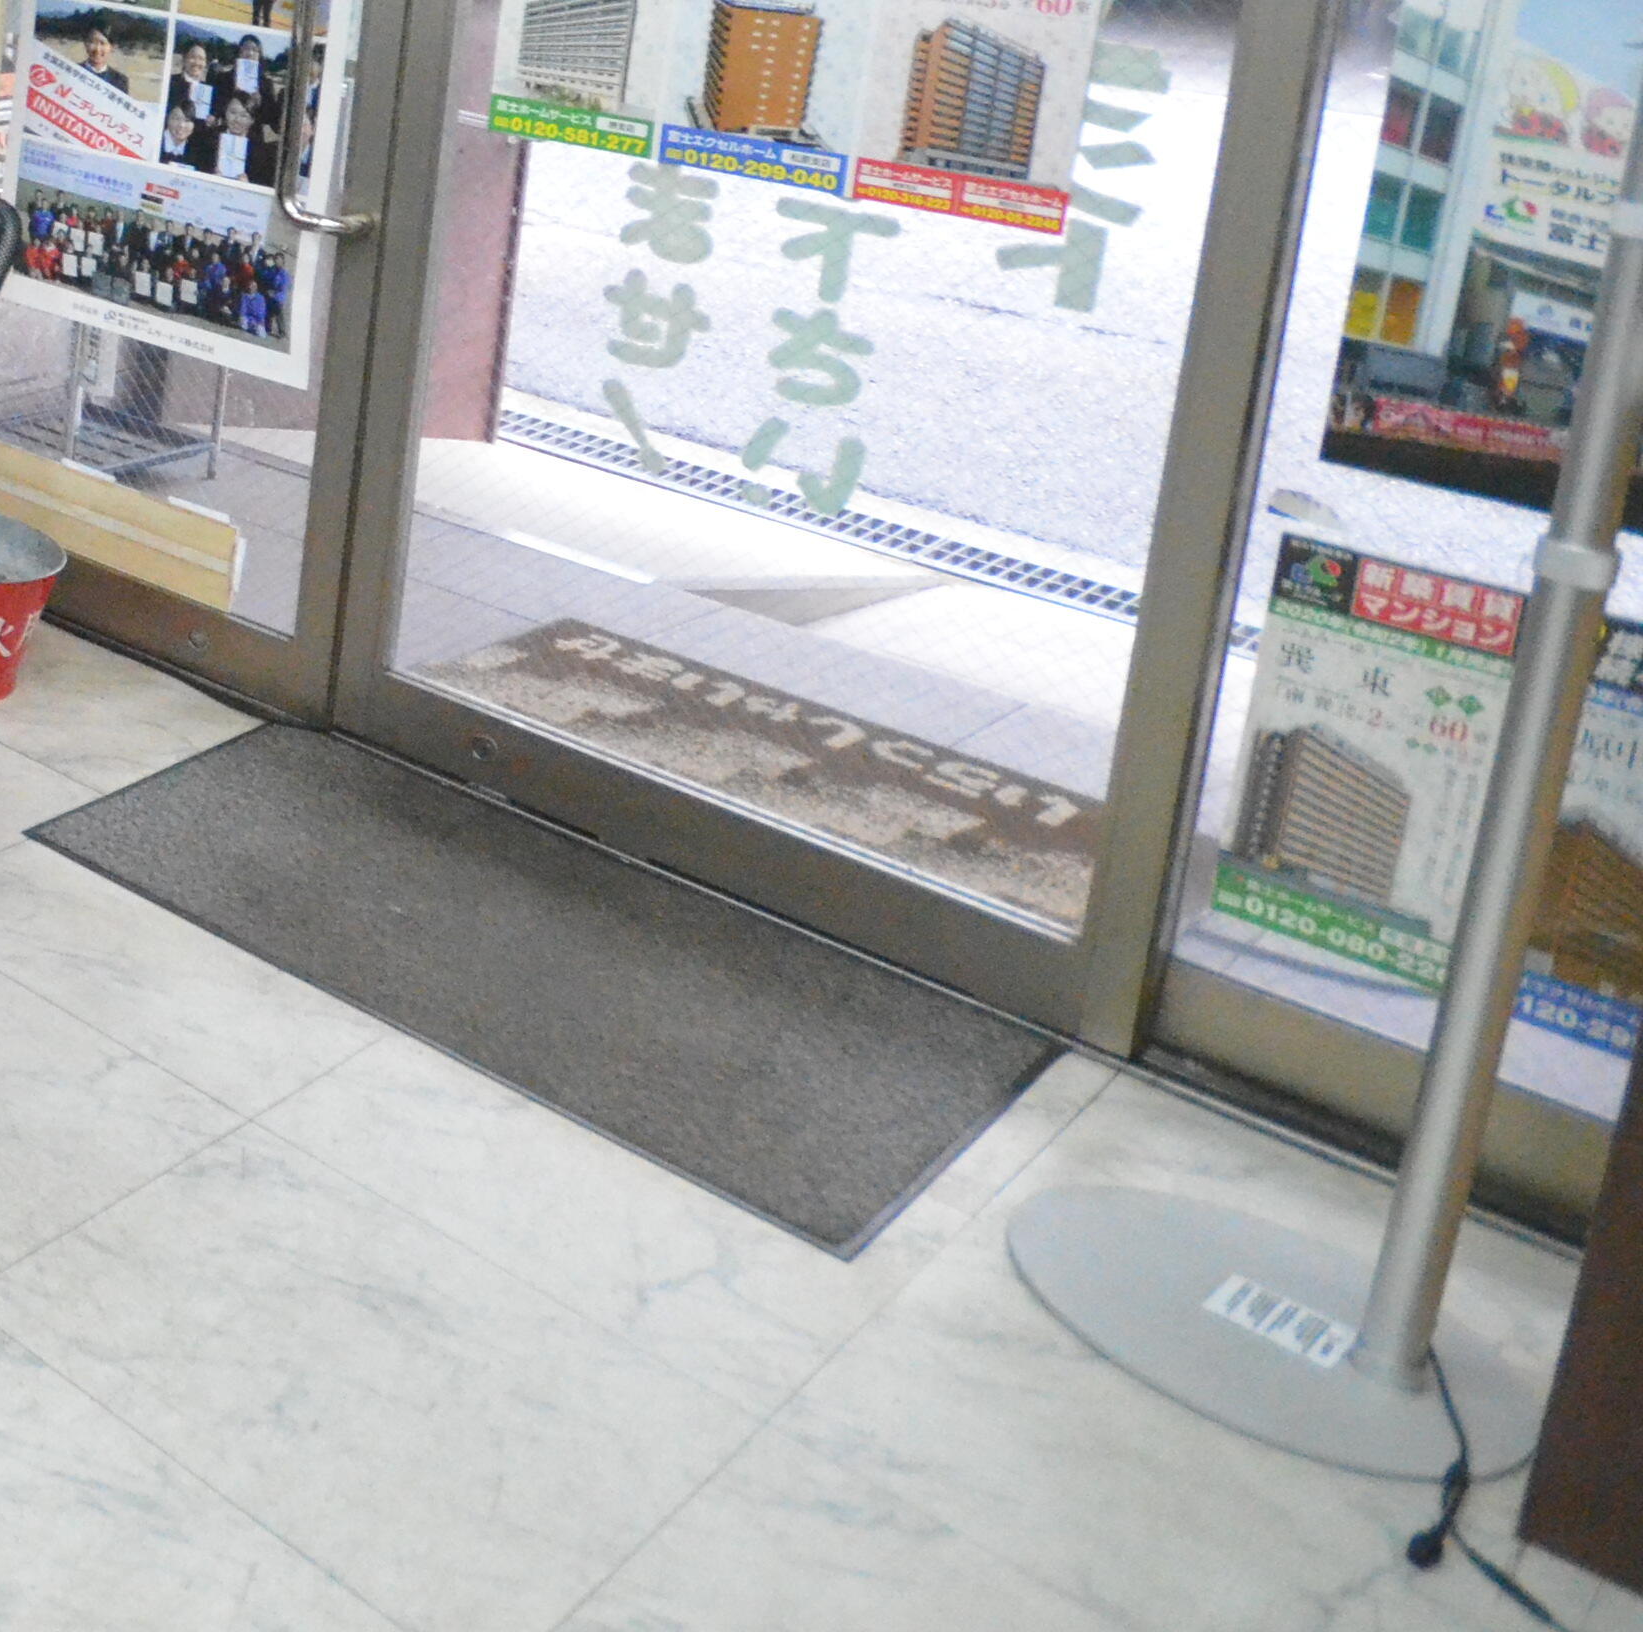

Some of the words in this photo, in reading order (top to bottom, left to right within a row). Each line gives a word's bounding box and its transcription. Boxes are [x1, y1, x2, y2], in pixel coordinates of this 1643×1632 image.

[32, 95, 121, 155] INVITATION
[511, 116, 647, 154] 0120-581-277
[683, 148, 838, 191] 0120-299-040
[1361, 594, 1510, 647] マンション
